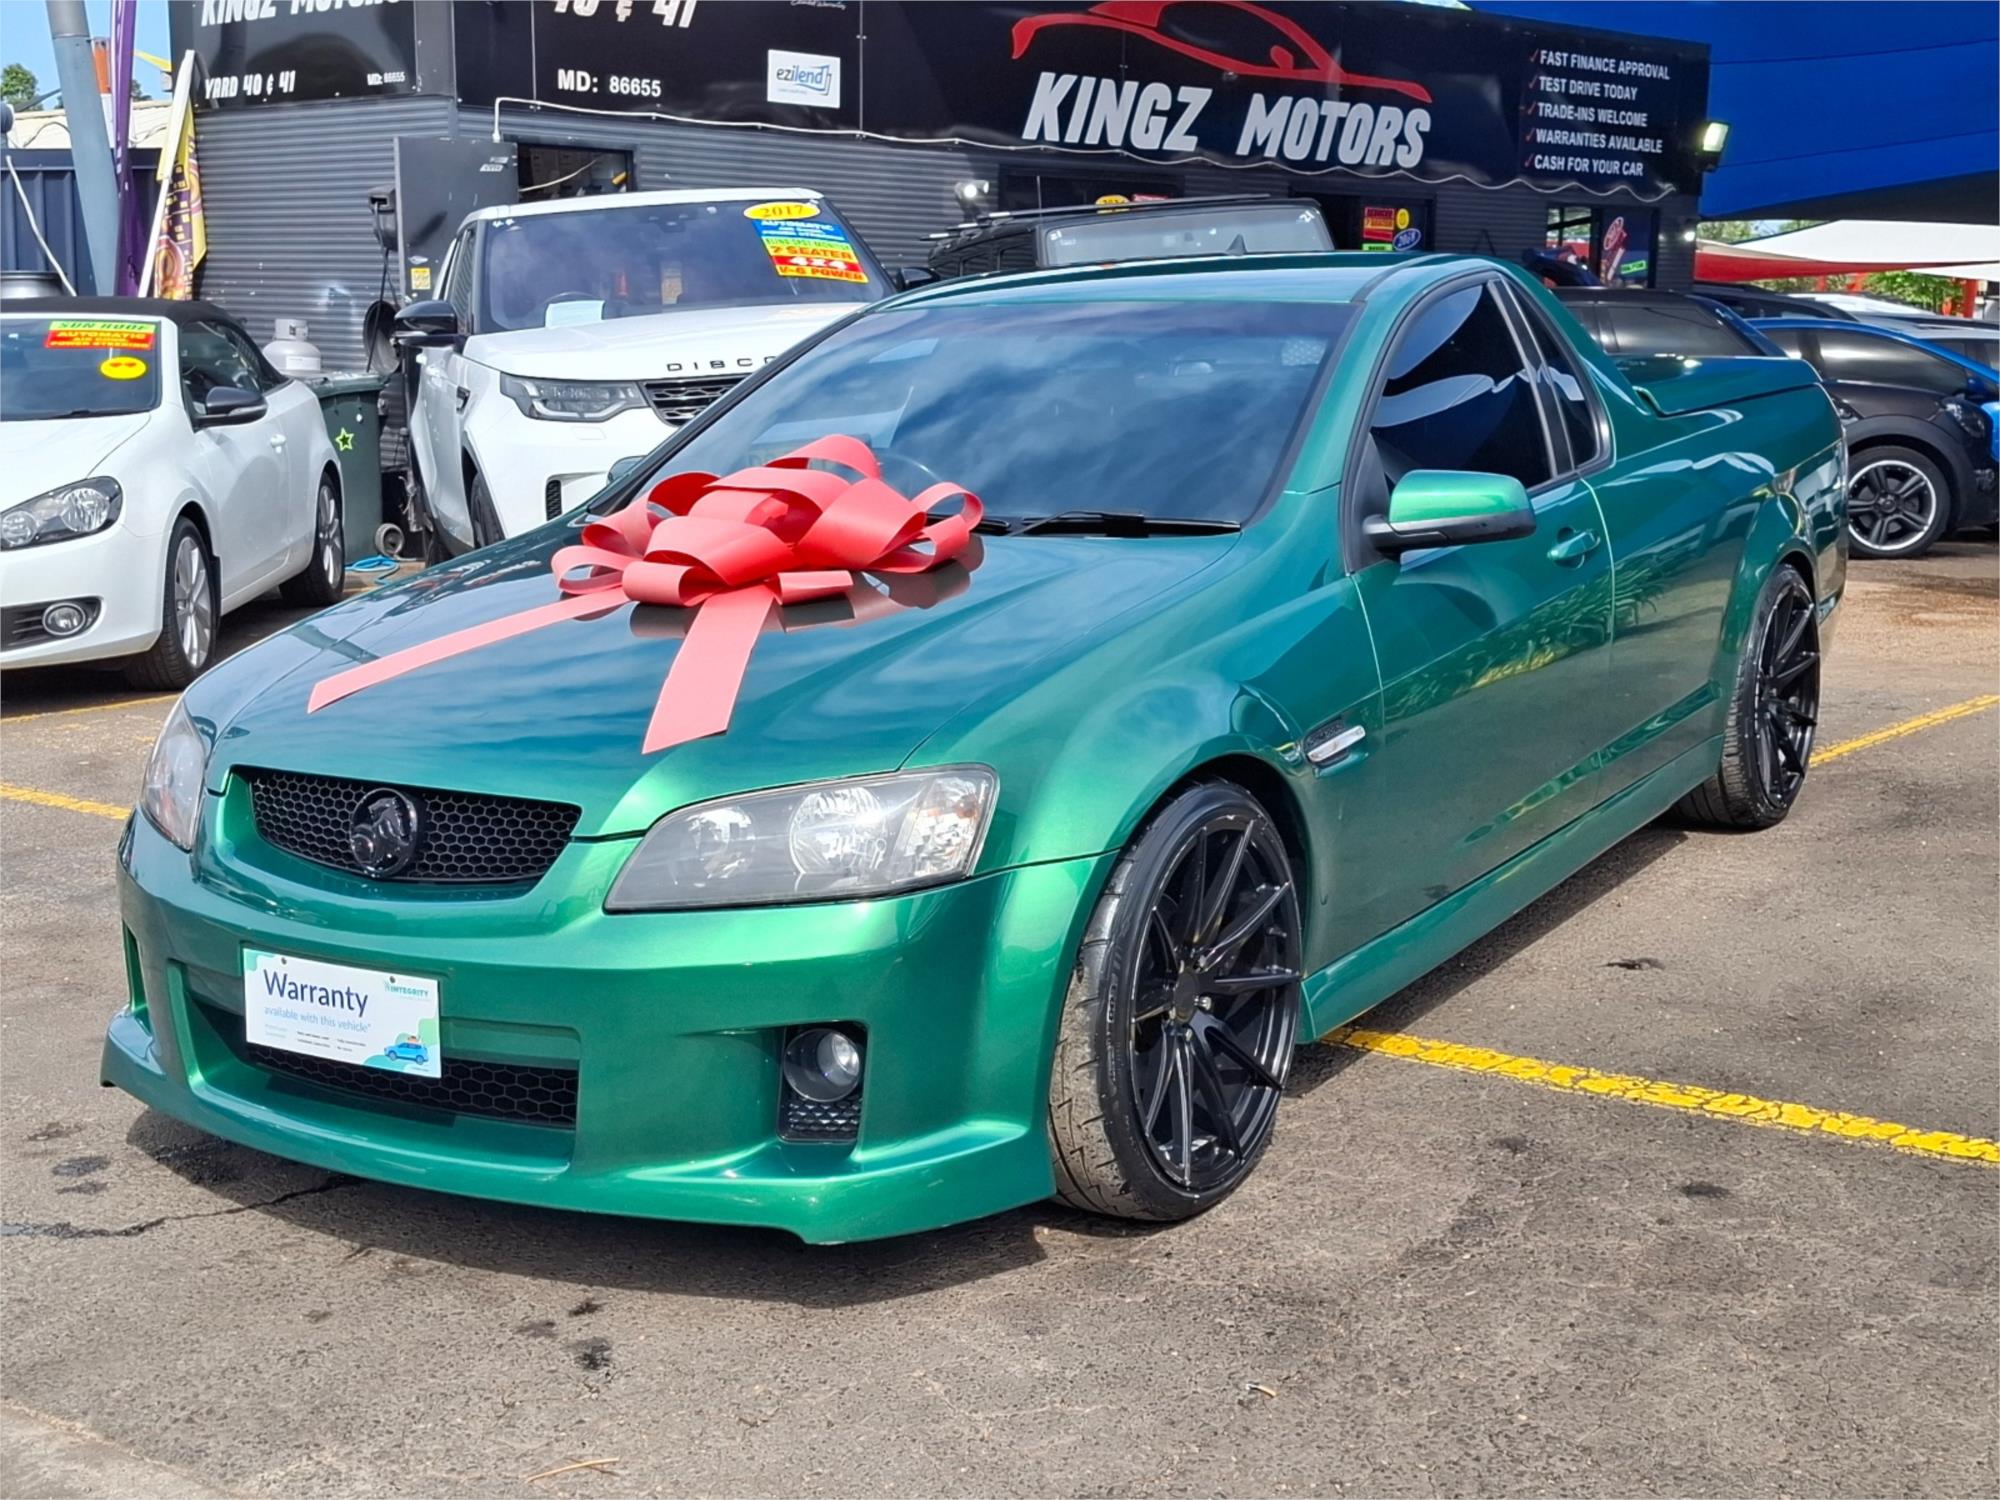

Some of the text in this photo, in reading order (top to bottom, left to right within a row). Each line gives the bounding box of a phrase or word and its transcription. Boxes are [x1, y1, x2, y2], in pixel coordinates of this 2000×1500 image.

[776, 64, 825, 84] ezilend
[1540, 50, 1670, 80] FAST FINANCE APPROVAL
[204, 76, 239, 99] YARD
[242, 72, 263, 97] 40
[278, 70, 296, 93] 41
[557, 68, 662, 97] MD: 86655
[1539, 76, 1638, 100] TEST DRIVE TODAY
[1021, 71, 1431, 168] KINGZ MOTORS
[1538, 102, 1648, 127] TRADE-INS WELCOME
[1536, 128, 1663, 153] WARRANTIES AVAILABLE
[1534, 155, 1644, 177] CASH FOR YOUR CAR
[760, 204, 804, 218] 2017
[785, 245, 853, 260] SEATER
[811, 268, 863, 280] POWER
[263, 968, 368, 1018] Warranty
[264, 1006, 298, 1021] available
[299, 1011, 319, 1025] with
[320, 1015, 336, 1028] this
